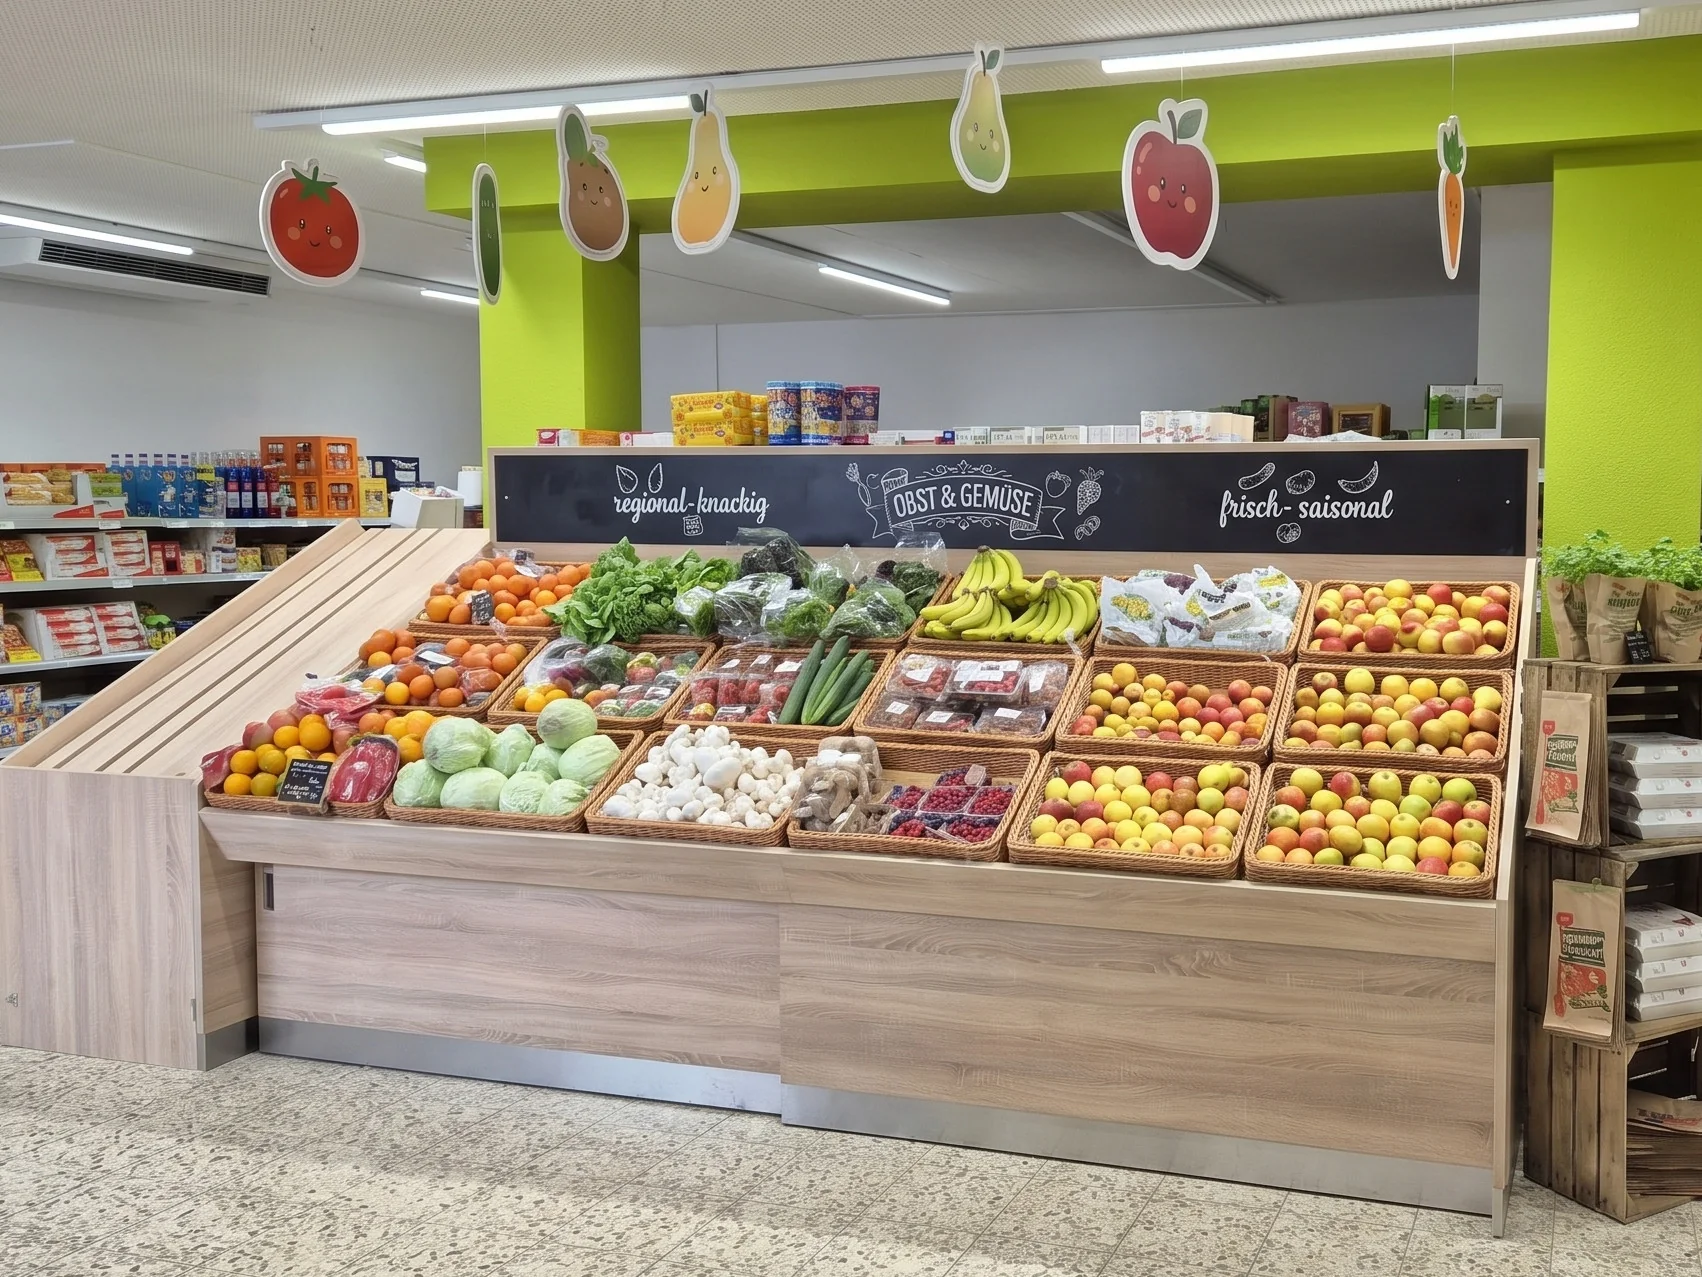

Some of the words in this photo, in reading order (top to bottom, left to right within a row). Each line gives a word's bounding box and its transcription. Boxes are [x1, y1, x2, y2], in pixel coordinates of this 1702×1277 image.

[613, 486, 770, 524] regional-knackig
[893, 486, 938, 518] OBST
[941, 484, 957, 509] &
[960, 482, 1035, 518] GEMÜSE
[1219, 488, 1292, 528] frisch-
[1298, 489, 1394, 519] saisonal
